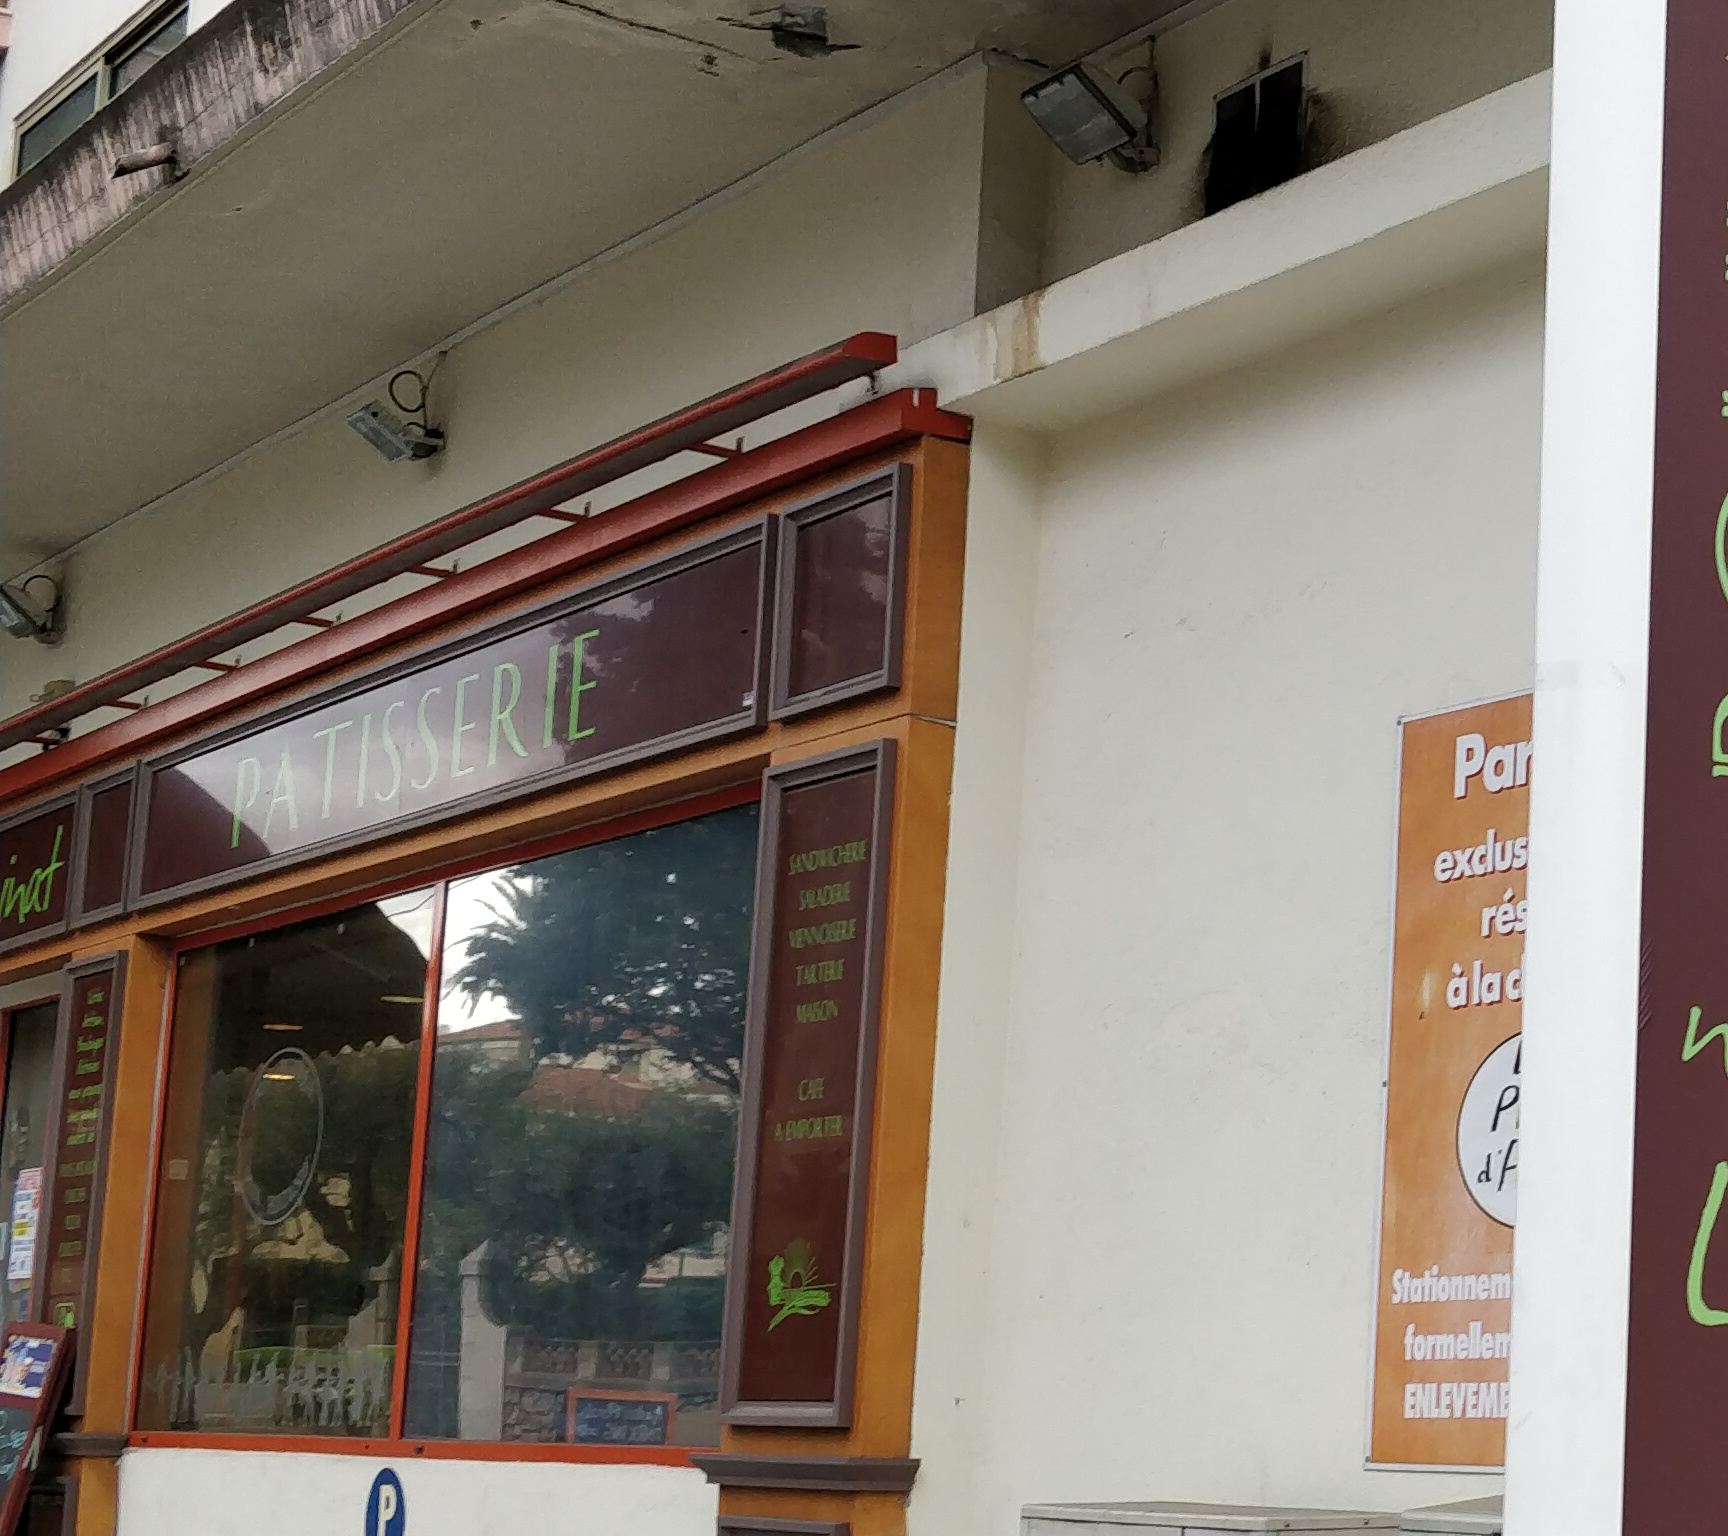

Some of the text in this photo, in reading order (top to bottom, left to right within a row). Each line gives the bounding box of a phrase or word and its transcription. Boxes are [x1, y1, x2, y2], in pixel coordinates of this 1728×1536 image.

[230, 628, 601, 849] PATISSERIE
[1453, 732, 1533, 799] Par
[0, 824, 65, 924] inat
[1434, 827, 1529, 883] exclus
[1479, 886, 1528, 938] rés
[1446, 961, 1469, 1010] à
[1471, 958, 1502, 1006] la
[1391, 1264, 1513, 1305] Stationnem
[1403, 1320, 1512, 1361] formellem
[1403, 1381, 1510, 1420] ENLEVEME
